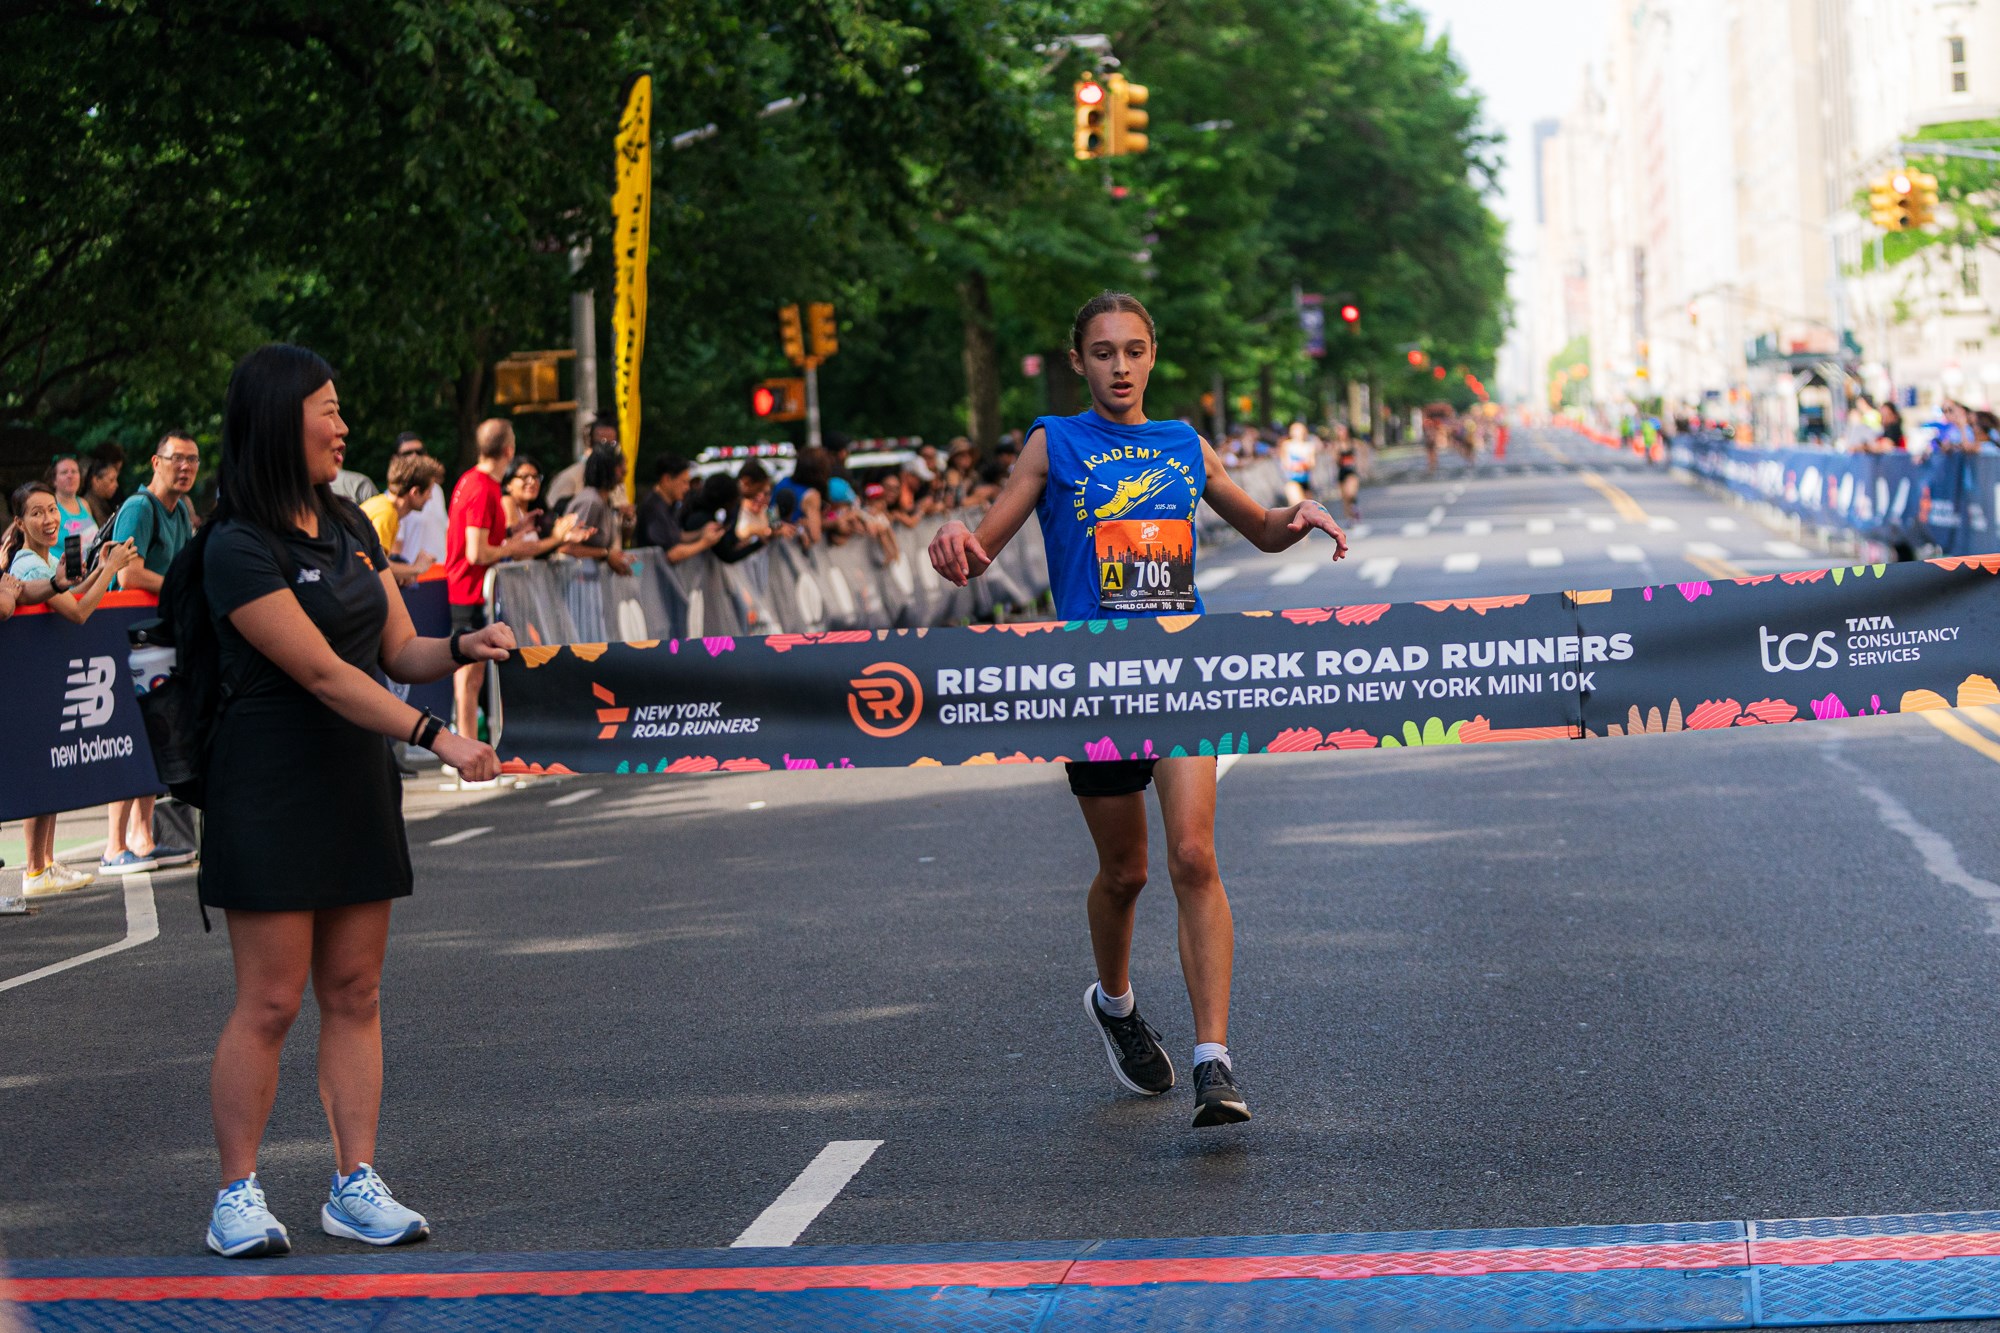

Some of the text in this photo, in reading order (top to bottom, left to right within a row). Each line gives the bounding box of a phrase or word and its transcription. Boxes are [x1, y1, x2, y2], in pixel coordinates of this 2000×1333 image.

[1073, 476, 1089, 521] BELL
[1083, 445, 1162, 471] ACADEMY
[1103, 564, 1122, 588] A
[1134, 560, 1171, 588] 706
[1161, 602, 1171, 610] 706
[1845, 615, 1895, 632] TATA
[1759, 625, 1839, 673] tcs
[1847, 626, 1960, 650] CONSULTANCY
[937, 632, 1634, 696] RISING NEW YORK ROAD RUNNERS
[1848, 647, 1920, 667] SERVICES
[938, 670, 1597, 726] GIRLS RUN AT THE MASTERCARD NEW YORK MINI 10K
[633, 701, 722, 722] NEW YORK
[632, 717, 761, 739] ROAD RUNNERS
[50, 734, 133, 769] new balance
